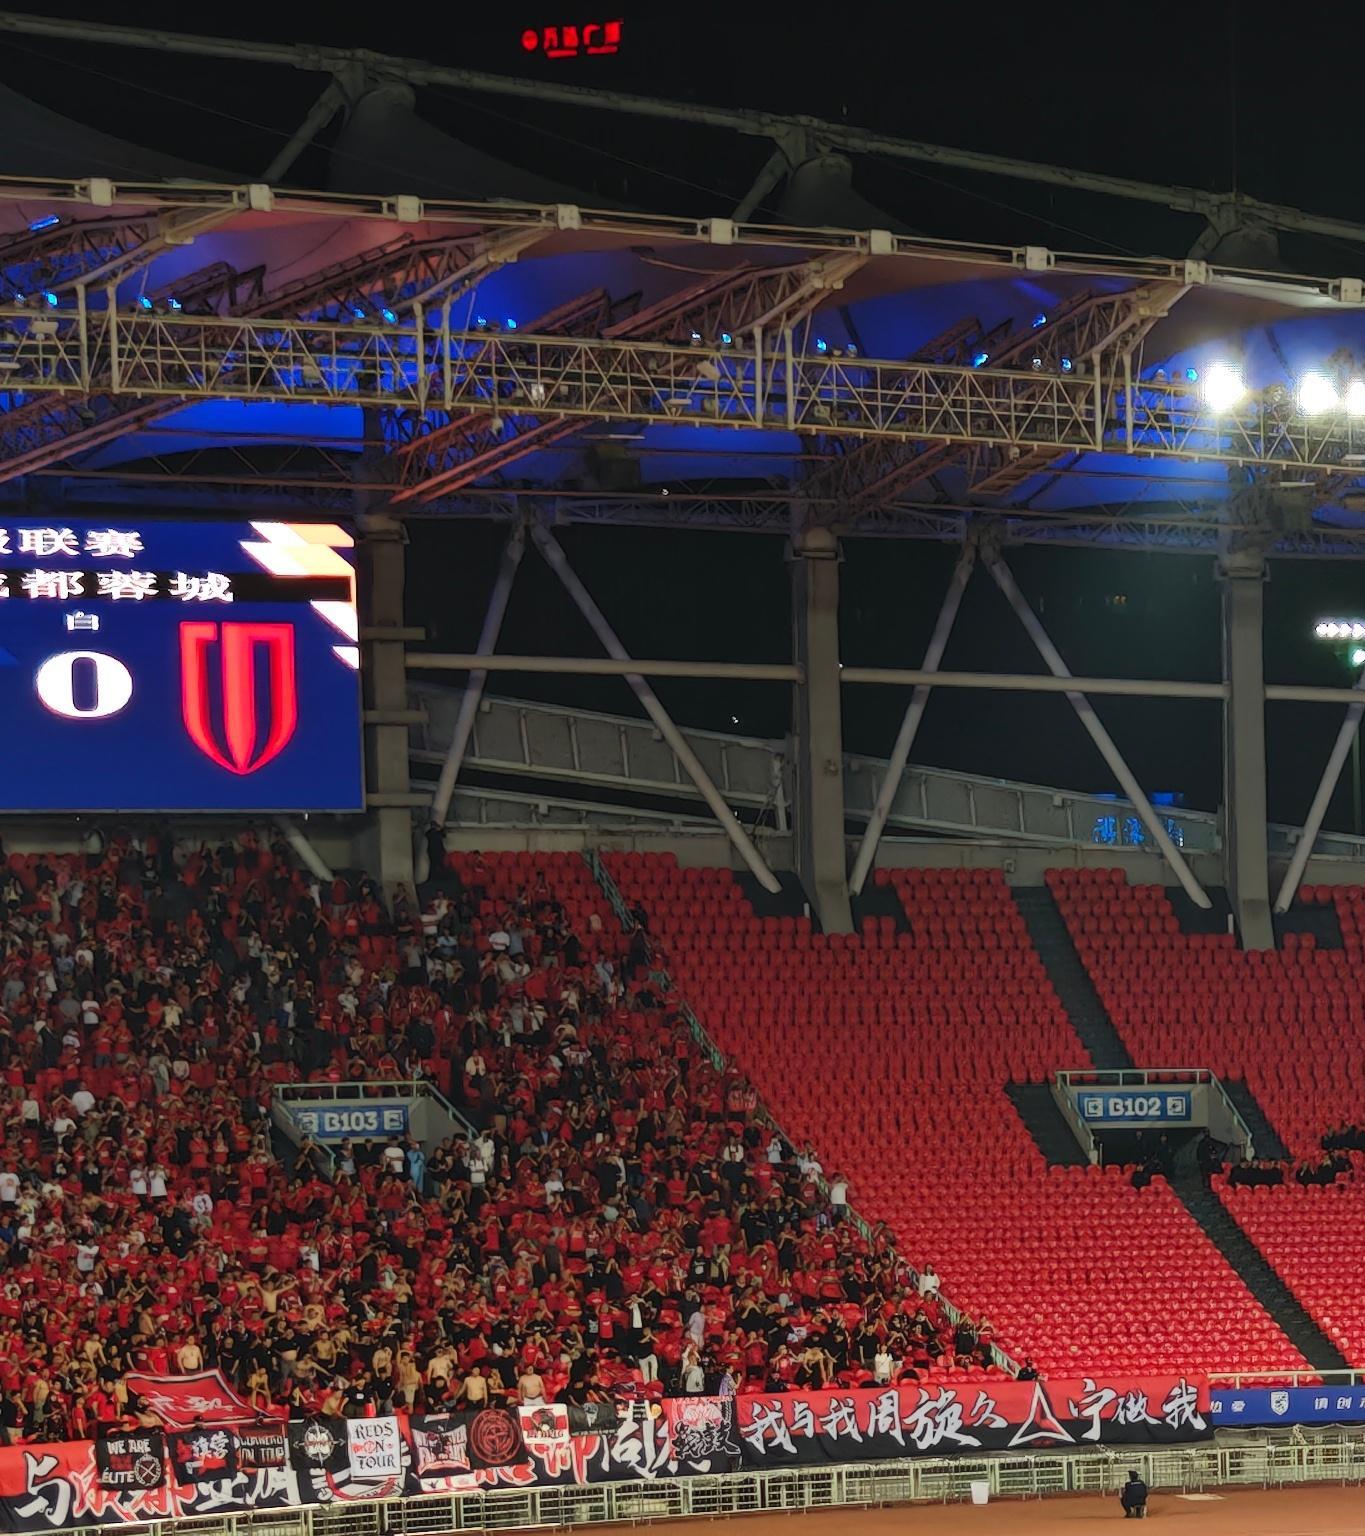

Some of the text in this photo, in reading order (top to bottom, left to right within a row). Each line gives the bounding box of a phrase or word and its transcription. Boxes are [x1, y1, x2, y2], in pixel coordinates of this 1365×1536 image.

[0, 569, 234, 602] 都蓉城
[36, 650, 134, 718] 0
[1109, 1097, 1161, 1117] B102
[354, 1422, 394, 1437] REDS
[357, 1455, 396, 1470] TOUR
